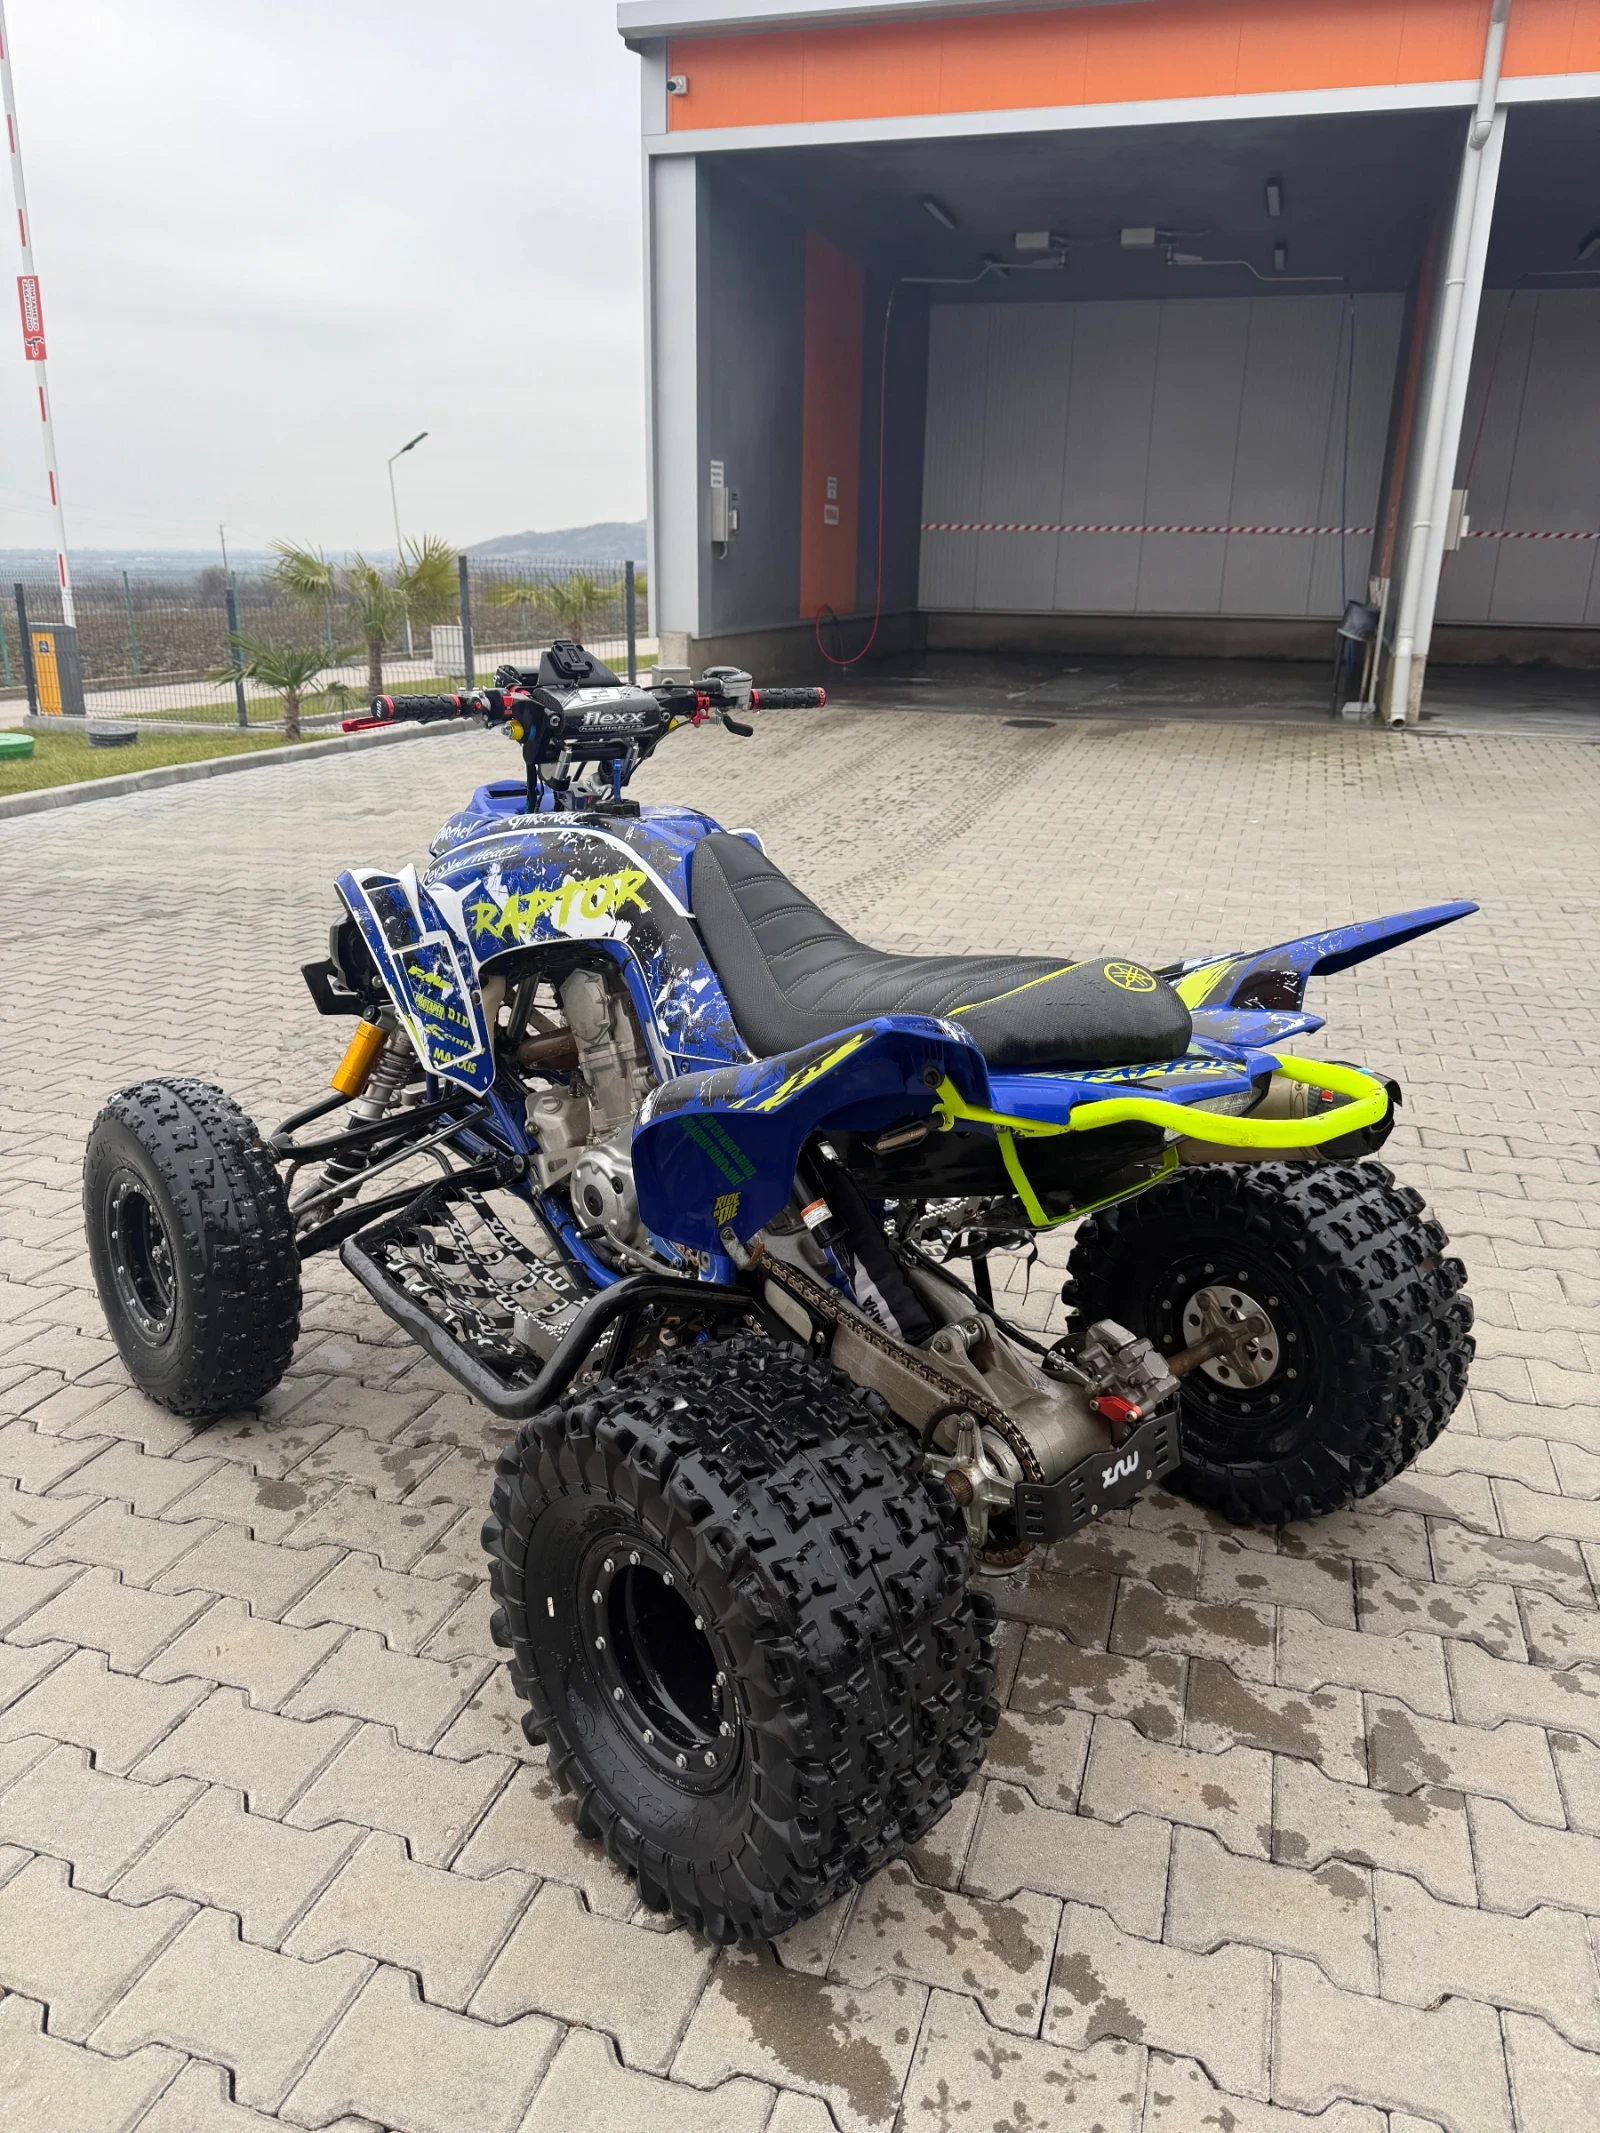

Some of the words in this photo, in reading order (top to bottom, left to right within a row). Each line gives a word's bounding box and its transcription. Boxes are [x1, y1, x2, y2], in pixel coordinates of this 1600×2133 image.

[22, 280, 33, 330] ЗАБРАНЕНО
[28, 280, 39, 330] ВЛИЗАНЕТО
[465, 867, 651, 942] RAPTOR
[714, 1191, 742, 1210] RIDE
[718, 1203, 740, 1226] DIE
